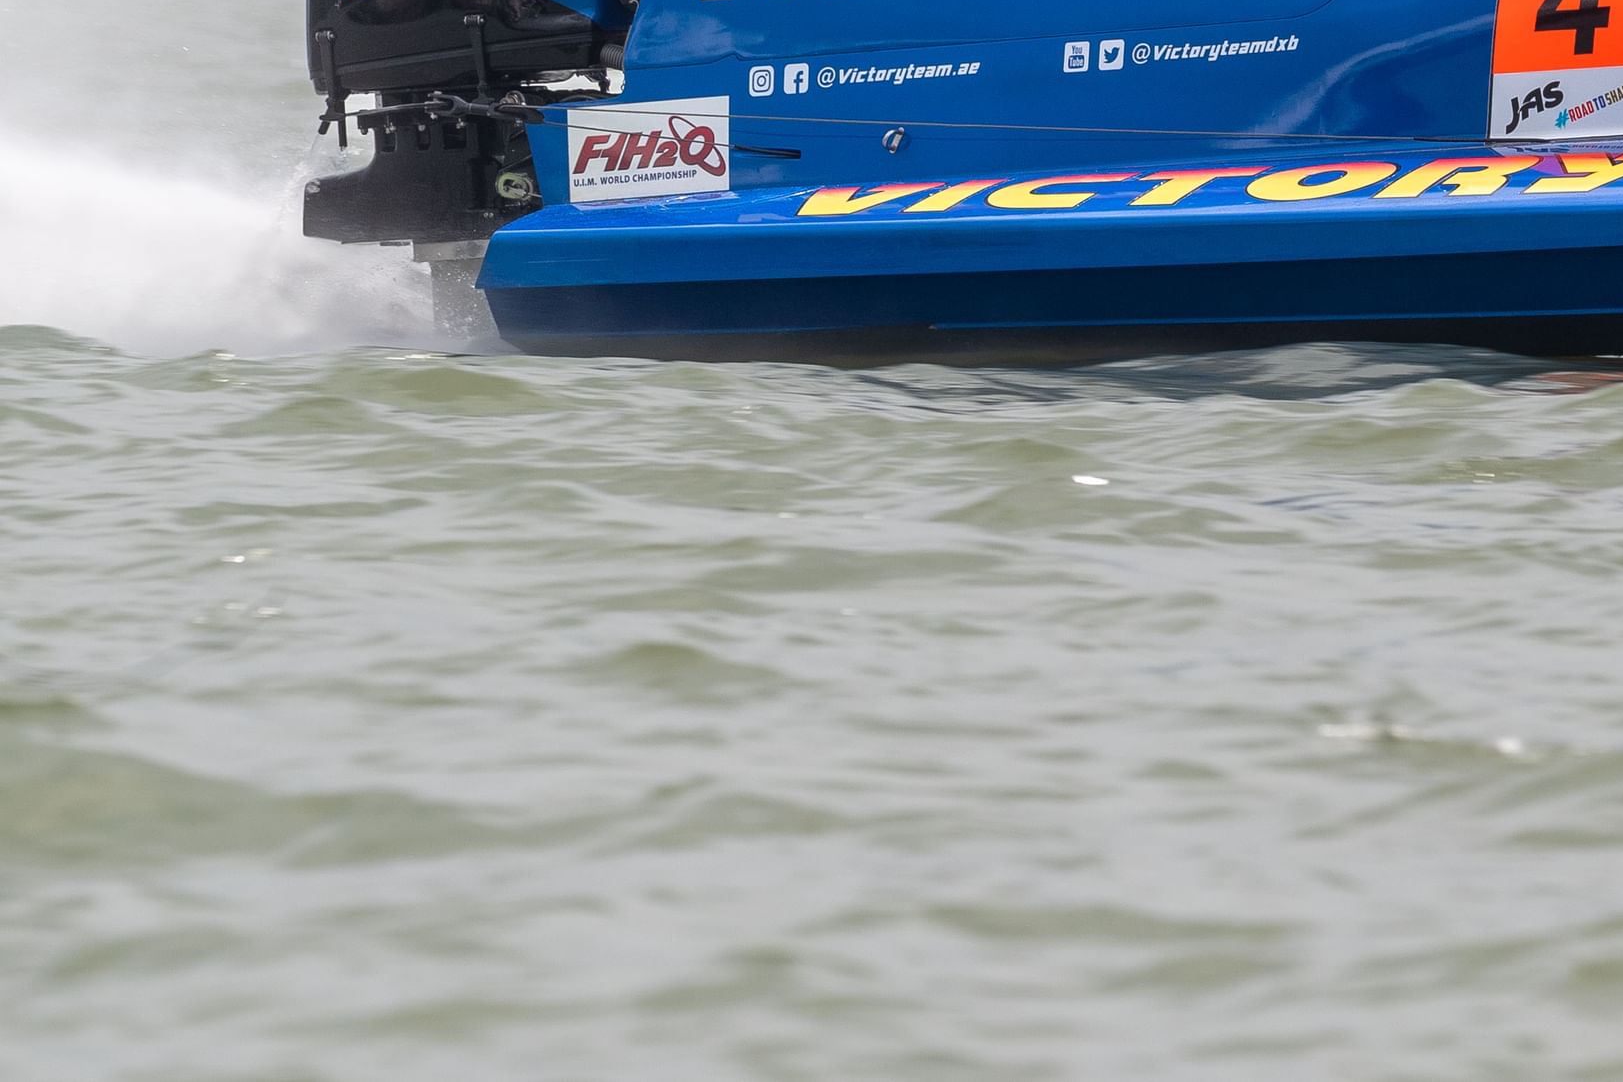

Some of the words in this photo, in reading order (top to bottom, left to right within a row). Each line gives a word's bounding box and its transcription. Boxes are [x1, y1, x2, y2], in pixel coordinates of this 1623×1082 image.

[1131, 34, 1299, 65] @Victoryteamdxb
[816, 61, 981, 89] @Victoryteam.ae
[1505, 80, 1565, 135] JAS
[573, 176, 597, 187] U.I.M.
[600, 174, 630, 185] WORLD
[632, 169, 697, 182] CHAMPIONSHIP
